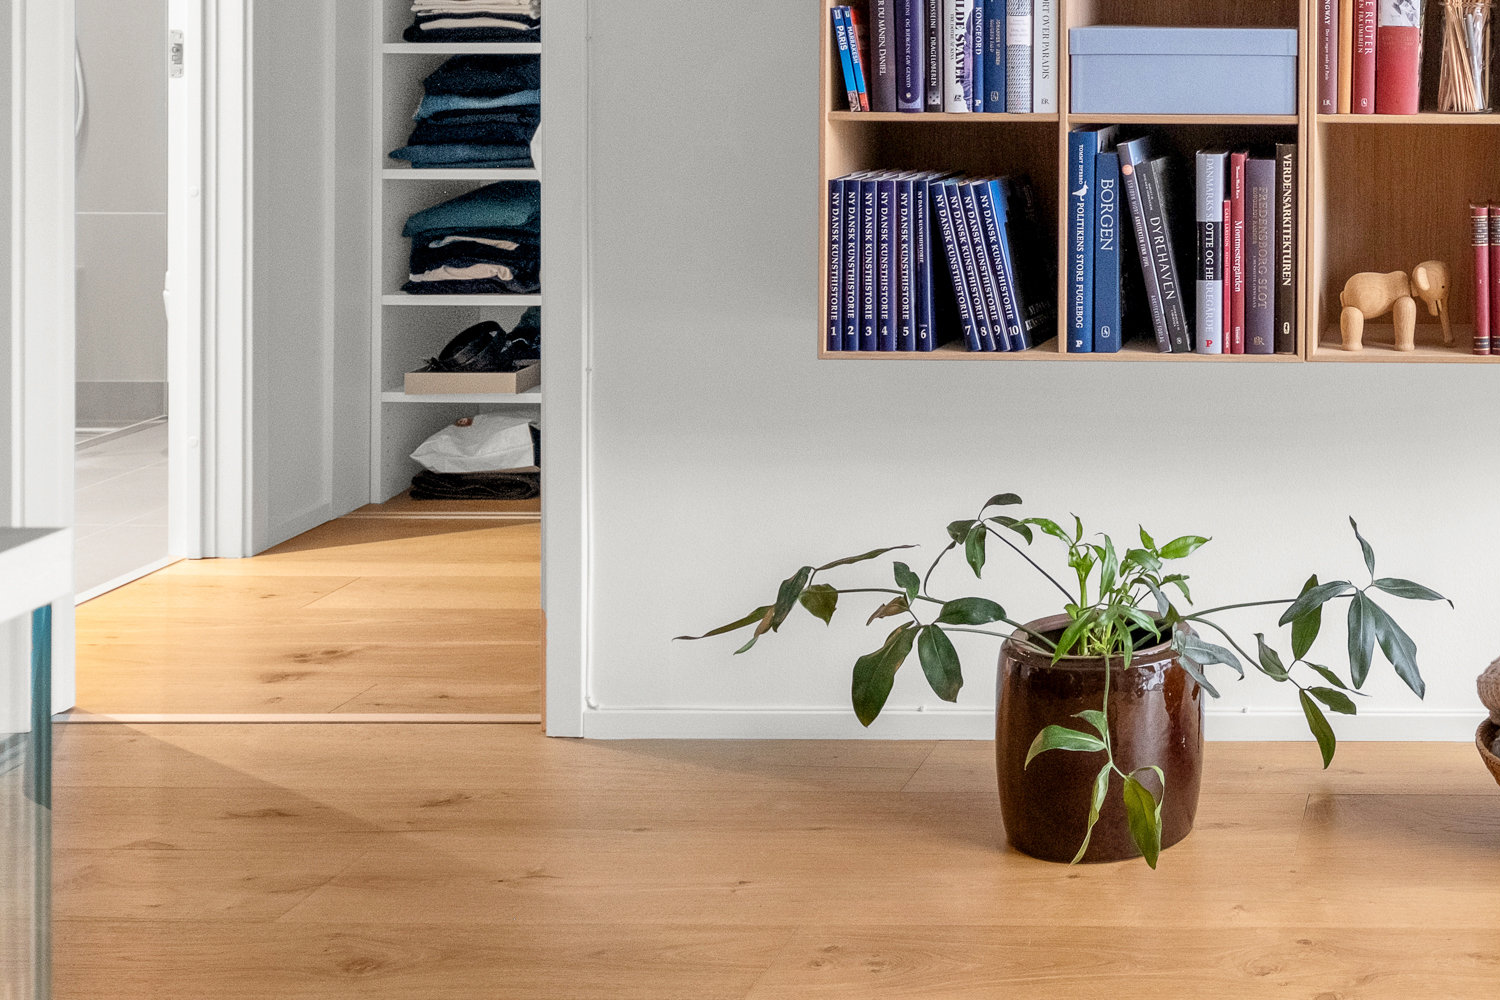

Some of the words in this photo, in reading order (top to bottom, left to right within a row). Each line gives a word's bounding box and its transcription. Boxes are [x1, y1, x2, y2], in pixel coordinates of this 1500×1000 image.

[878, 8, 885, 18] DU
[836, 25, 847, 51] PARIS
[847, 26, 859, 64] MARRAKESH
[1365, 12, 1373, 55] REUTER
[955, 34, 964, 84] SVANER
[1206, 158, 1214, 210] DANMARKS
[832, 193, 839, 207] NY
[848, 192, 855, 206] NY
[865, 193, 872, 207] NY
[881, 192, 888, 206] NY
[900, 193, 908, 207] NY
[935, 195, 945, 207] NY
[949, 196, 958, 209] NY
[963, 196, 972, 209] NY
[980, 195, 989, 208] NY
[831, 209, 839, 241] DANSK
[938, 210, 951, 242] DANSK
[952, 211, 966, 244] DANSK
[967, 212, 980, 244] DANSK
[983, 210, 996, 242] DANSK
[1076, 202, 1084, 251] POLITIKENS
[1100, 179, 1113, 250] BORGEN
[1283, 154, 1291, 286] VERDENSARKITEKTUREN
[1134, 216, 1144, 243] ARKITEKTEN
[1205, 213, 1214, 249] SLOTTE
[1258, 187, 1267, 275] FREDENSBORG
[1076, 254, 1084, 282] STORE
[1150, 217, 1175, 300] DYREHAVEN
[1205, 252, 1214, 264] OG
[1233, 220, 1243, 292] Montmestergården
[901, 244, 909, 319] KUNSTHISTORIE
[946, 244, 968, 319] KUNSTHISTORIE
[961, 246, 983, 320] KUNSTHISTORIE
[975, 246, 998, 321] KUNSTHISTORIE
[990, 245, 1013, 319] KUNSTHISTORIE
[1258, 280, 1267, 309] SLOT
[1075, 284, 1084, 328] FUGLEBOG
[1205, 267, 1215, 333] HERREGÅRDE
[831, 327, 837, 336] 1
[848, 326, 854, 335] 2
[865, 327, 872, 336] 3
[882, 326, 888, 335] 4
[902, 327, 909, 336] 5
[964, 326, 971, 335] 7
[980, 327, 987, 337] 8
[994, 325, 1000, 335] 9
[1008, 326, 1019, 336] 10
